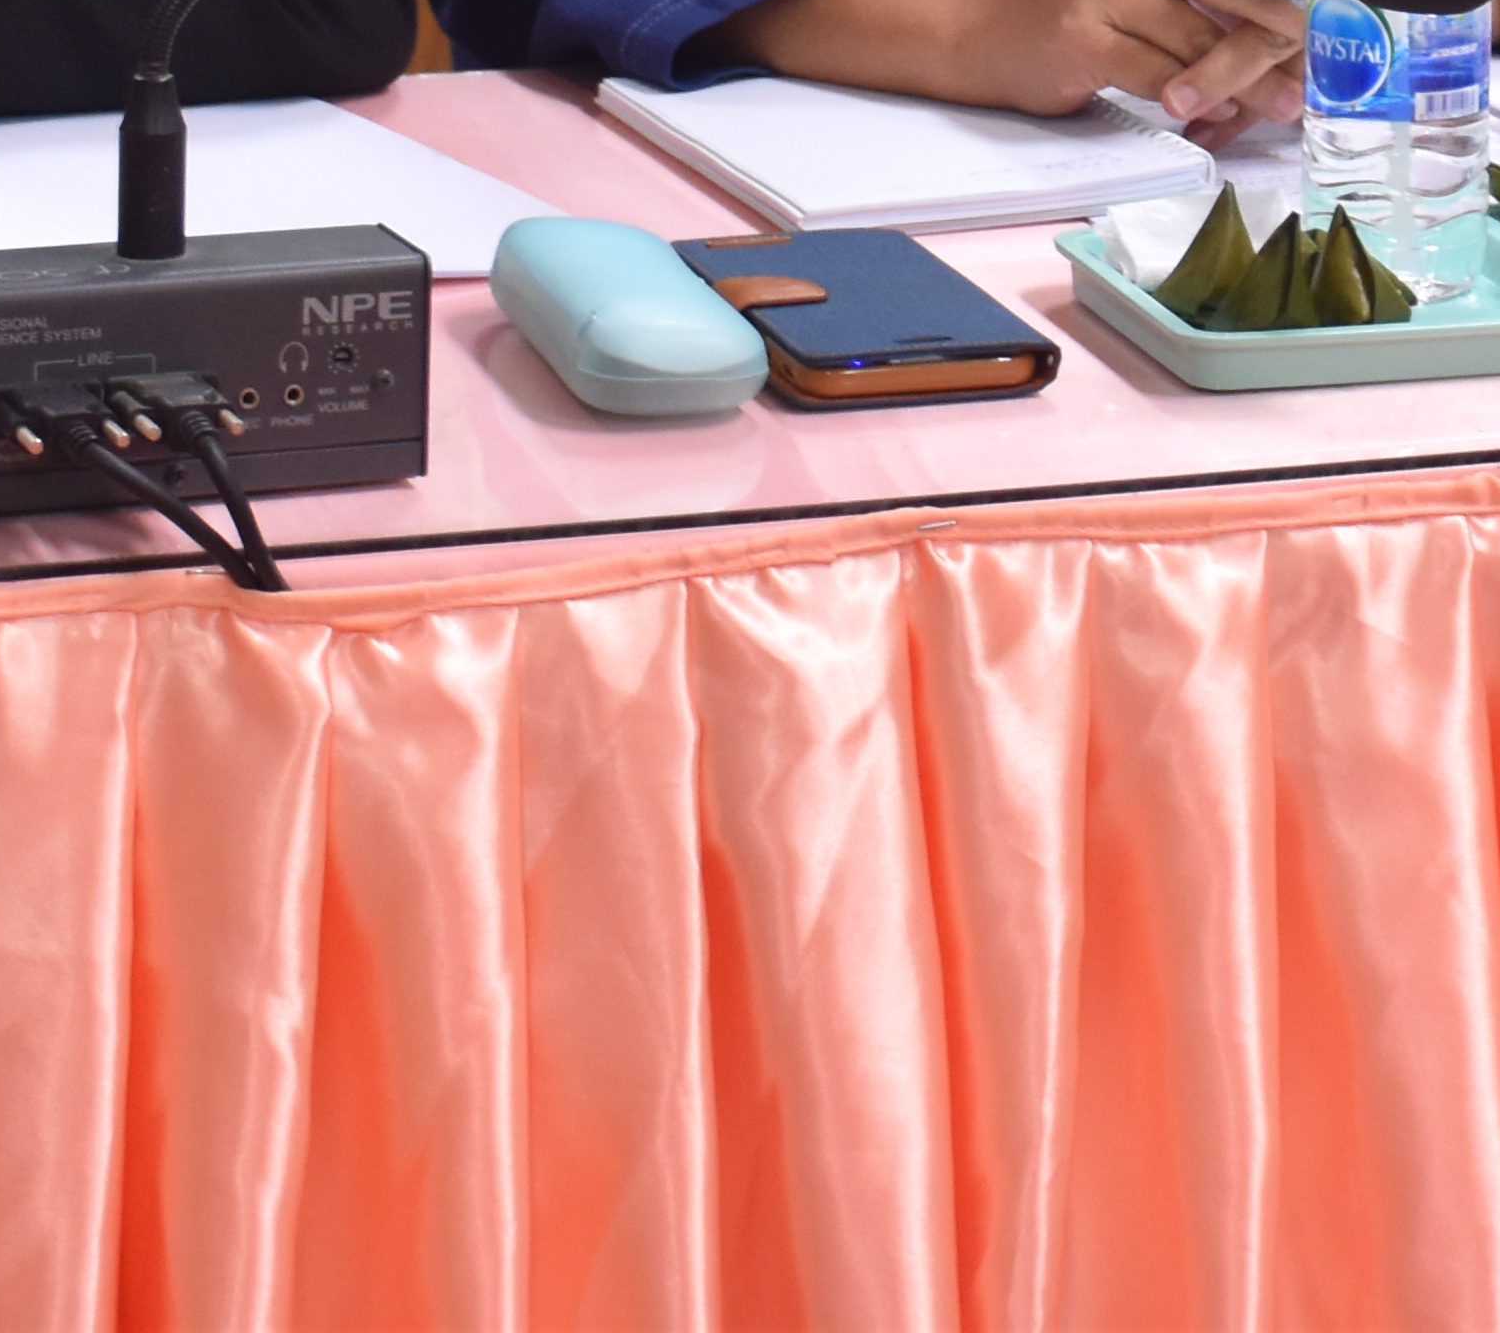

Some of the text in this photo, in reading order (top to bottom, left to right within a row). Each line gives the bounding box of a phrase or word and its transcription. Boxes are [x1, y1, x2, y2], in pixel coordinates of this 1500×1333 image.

[302, 290, 414, 325] NPE
[43, 327, 103, 343] SYSTEM
[302, 321, 414, 336] RESEARCH
[77, 351, 114, 367] LINE
[317, 398, 369, 414] VOLUME
[270, 413, 315, 428] PHONE
